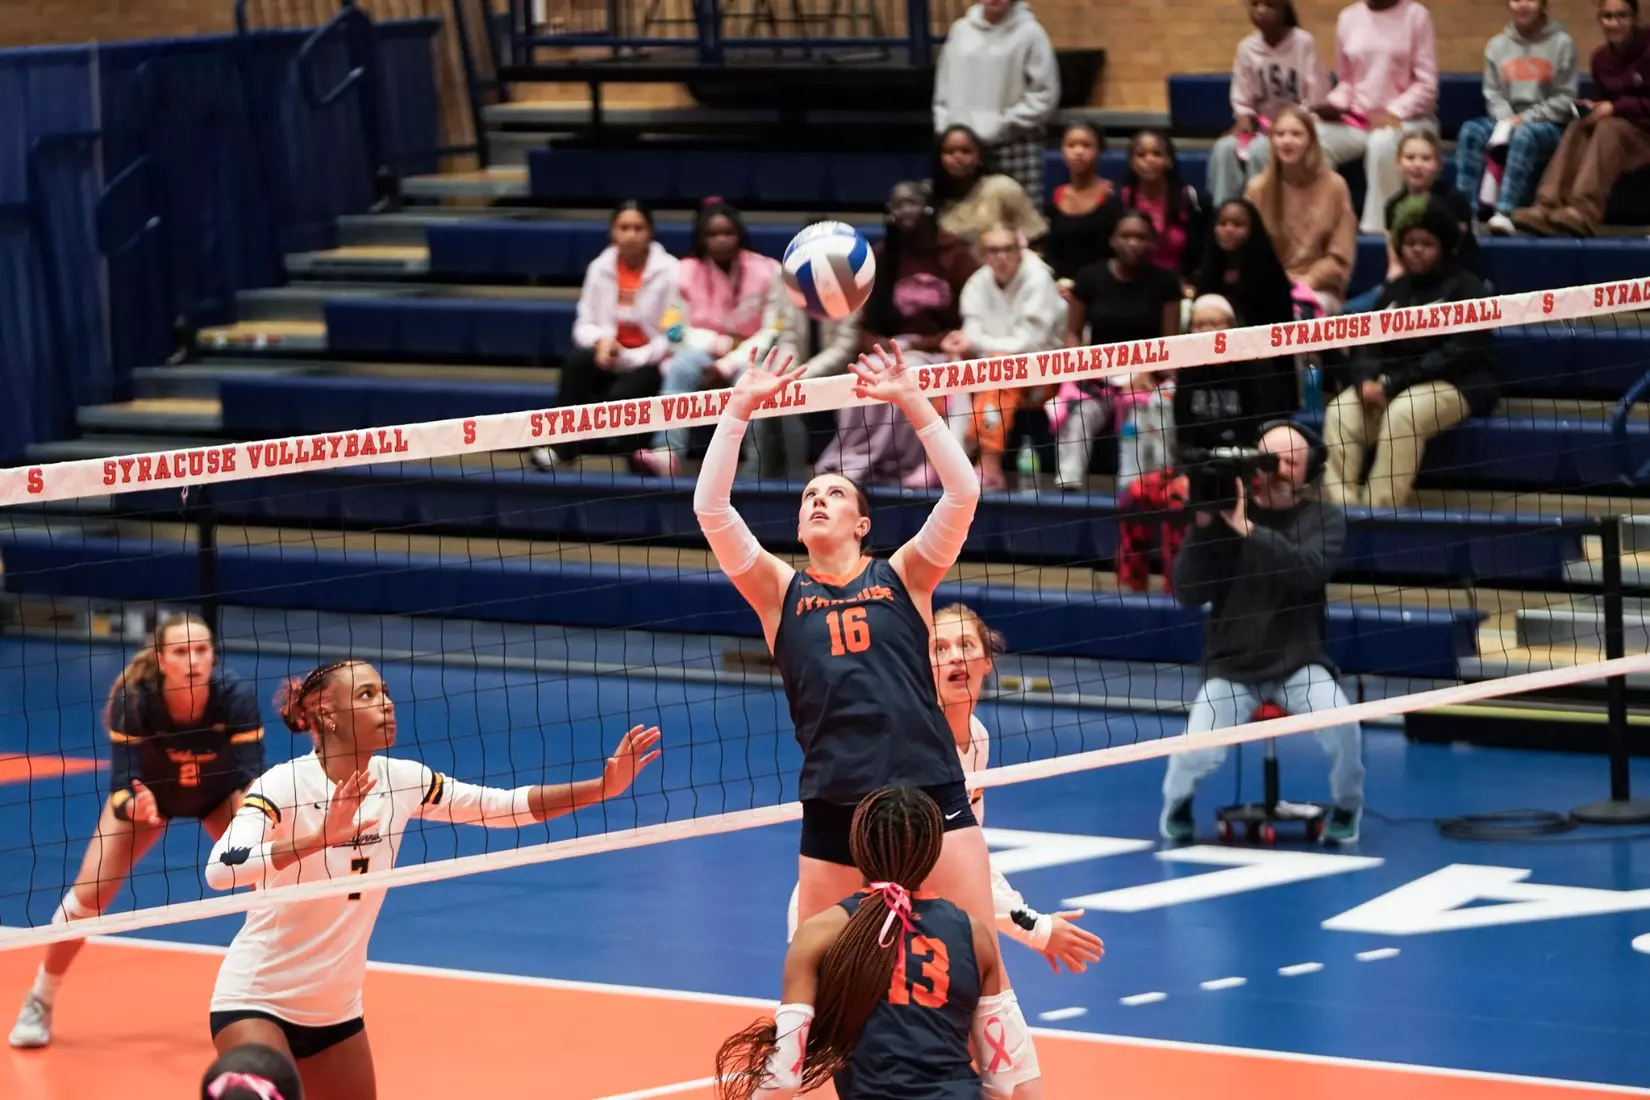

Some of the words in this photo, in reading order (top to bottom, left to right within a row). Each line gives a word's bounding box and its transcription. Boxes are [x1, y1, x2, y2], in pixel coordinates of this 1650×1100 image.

[26, 468, 44, 494] S
[103, 447, 237, 486] SYRACUSE
[246, 429, 409, 470] VOLLEYBALL
[463, 420, 477, 445] S
[530, 400, 652, 437] SYRACUSE
[661, 384, 806, 422] VOLLEALL
[918, 357, 1028, 391] SYRACUSE
[1036, 340, 1169, 377] VOLLEYBALL
[1214, 332, 1227, 354] S
[1270, 315, 1371, 347] SYRACUSE
[1379, 300, 1502, 334] VOLLEYBALL
[1542, 293, 1554, 314] S
[826, 606, 871, 656] 16
[347, 857, 370, 902] 7
[888, 935, 951, 1009] 13
